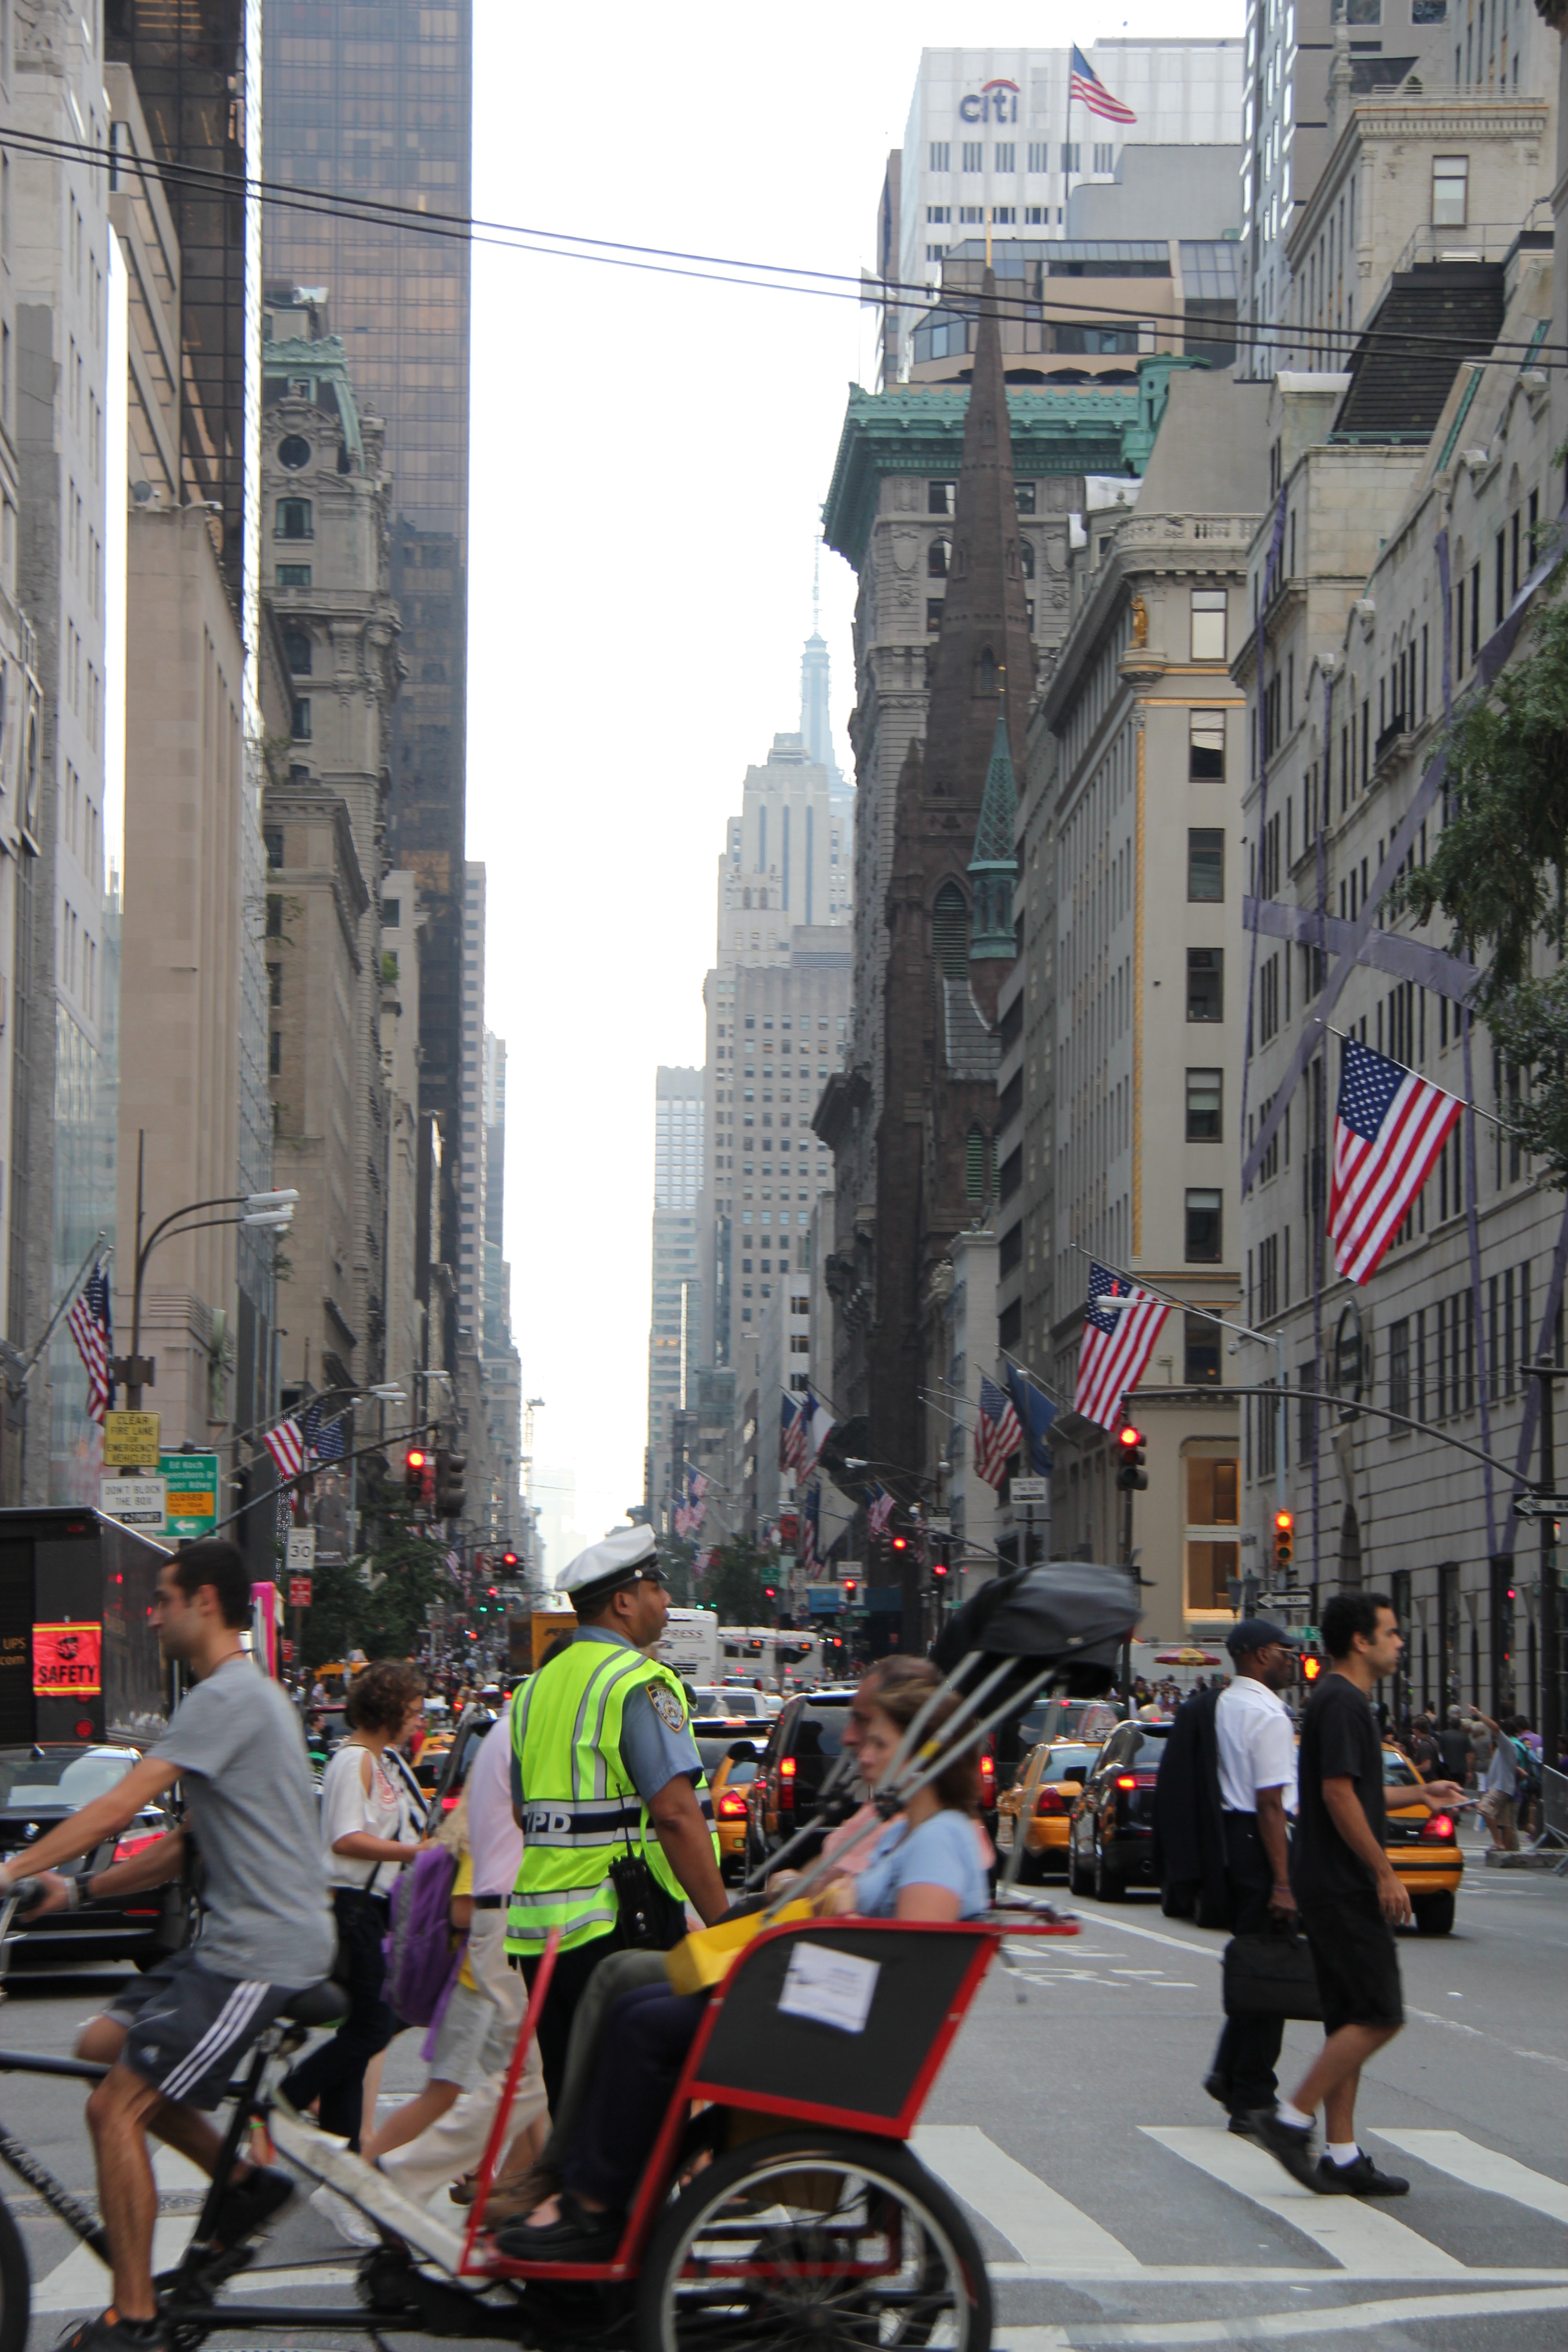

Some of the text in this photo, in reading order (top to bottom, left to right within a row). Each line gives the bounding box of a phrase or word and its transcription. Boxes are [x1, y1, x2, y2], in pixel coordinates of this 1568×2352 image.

[960, 88, 1017, 122] citi
[117, 1416, 149, 1425] CLEAR
[111, 1426, 154, 1435] FIRE LANE
[107, 1443, 156, 1451] EMERGENCY
[112, 1454, 152, 1462] VEHICLES
[134, 1485, 161, 1494] BLOCK
[116, 1497, 152, 1506] THE BOX
[1522, 1500, 1542, 1509] ONE
[290, 1545, 310, 1558] 30
[664, 1629, 704, 1639] PRESS
[3, 1638, 26, 1649] UPS
[39, 1665, 96, 1683] SAFETY
[527, 1811, 571, 1832] YPD
